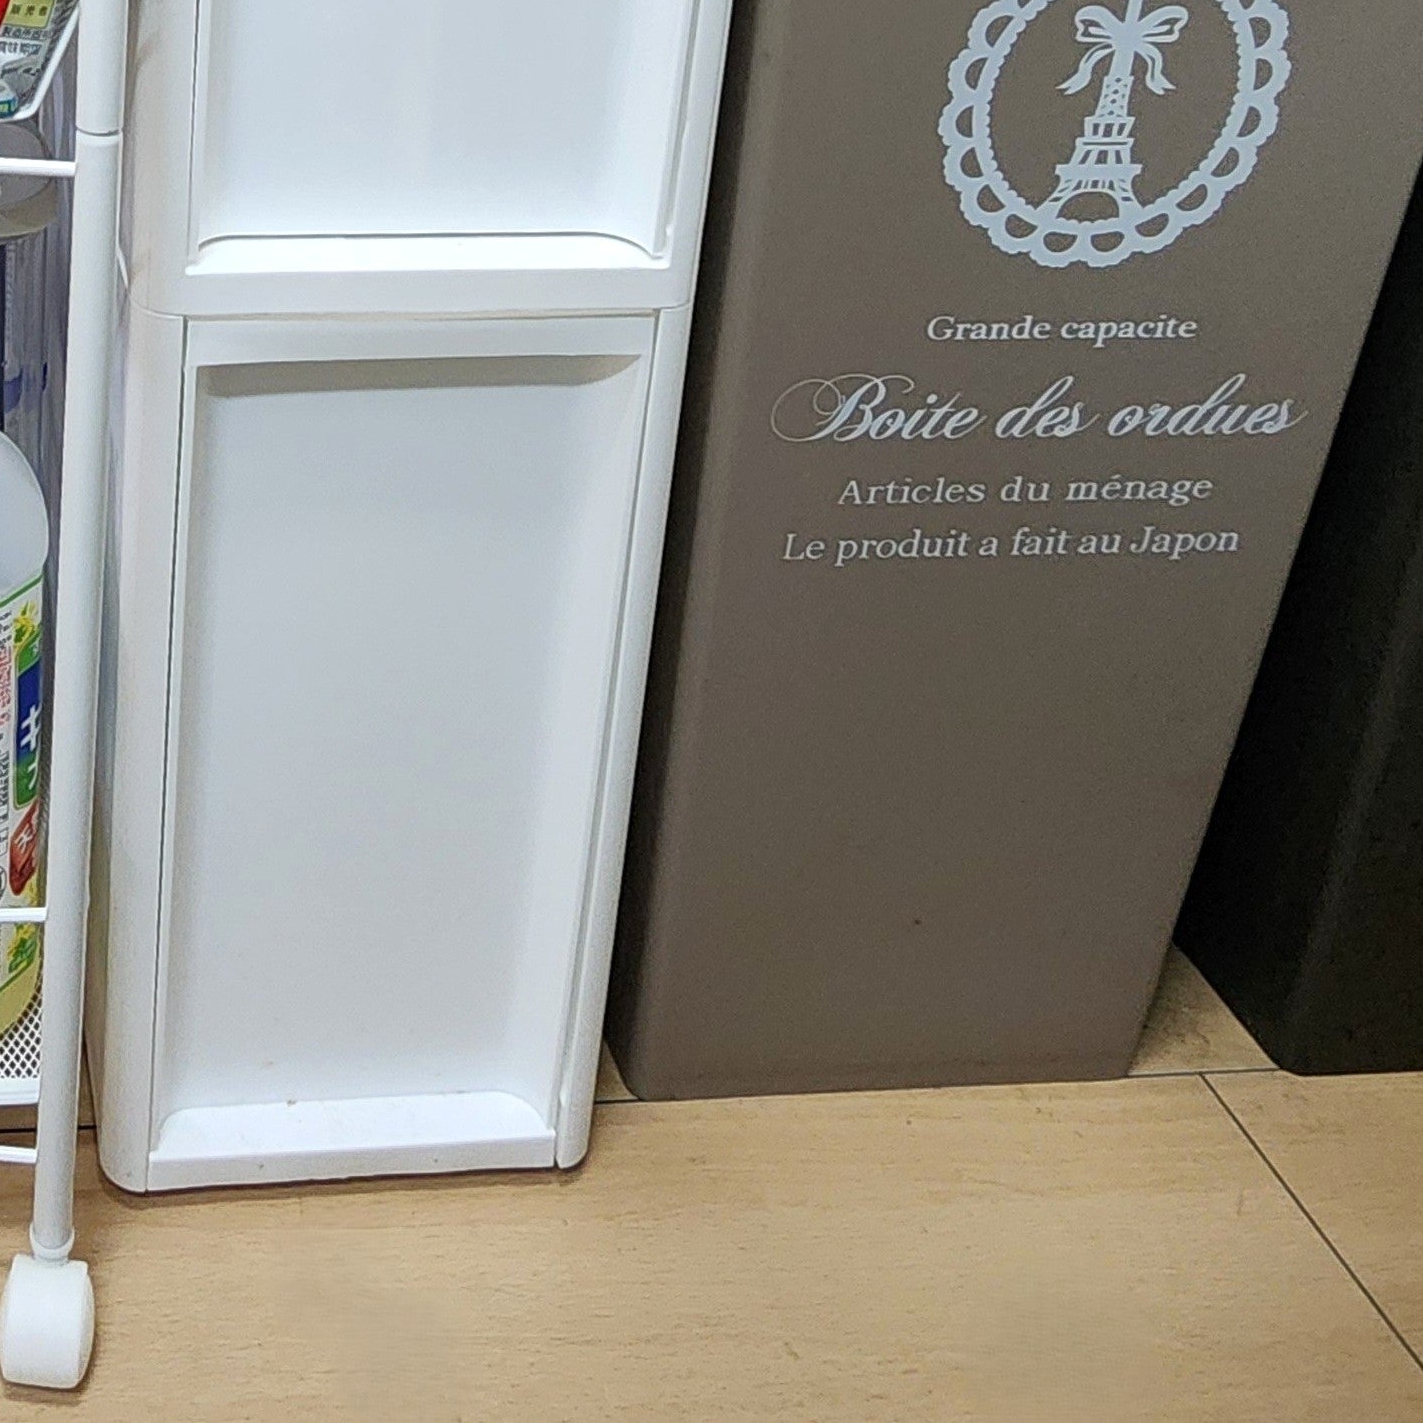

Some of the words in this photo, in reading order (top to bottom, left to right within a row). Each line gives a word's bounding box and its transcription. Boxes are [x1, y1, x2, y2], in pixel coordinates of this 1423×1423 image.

[927, 315, 1050, 342] Grande
[1060, 315, 1199, 348] capacite
[771, 373, 985, 443] Boite
[995, 375, 1099, 438] des
[1108, 373, 1309, 436] ordues
[838, 478, 986, 504] Articles
[1001, 476, 1050, 502] du
[1065, 474, 1214, 507] ménage
[783, 533, 826, 561] Le
[835, 529, 971, 566] produit
[978, 537, 999, 556] a
[1010, 526, 1070, 556] fait
[1077, 534, 1121, 554] au
[1130, 526, 1240, 561] Japon
